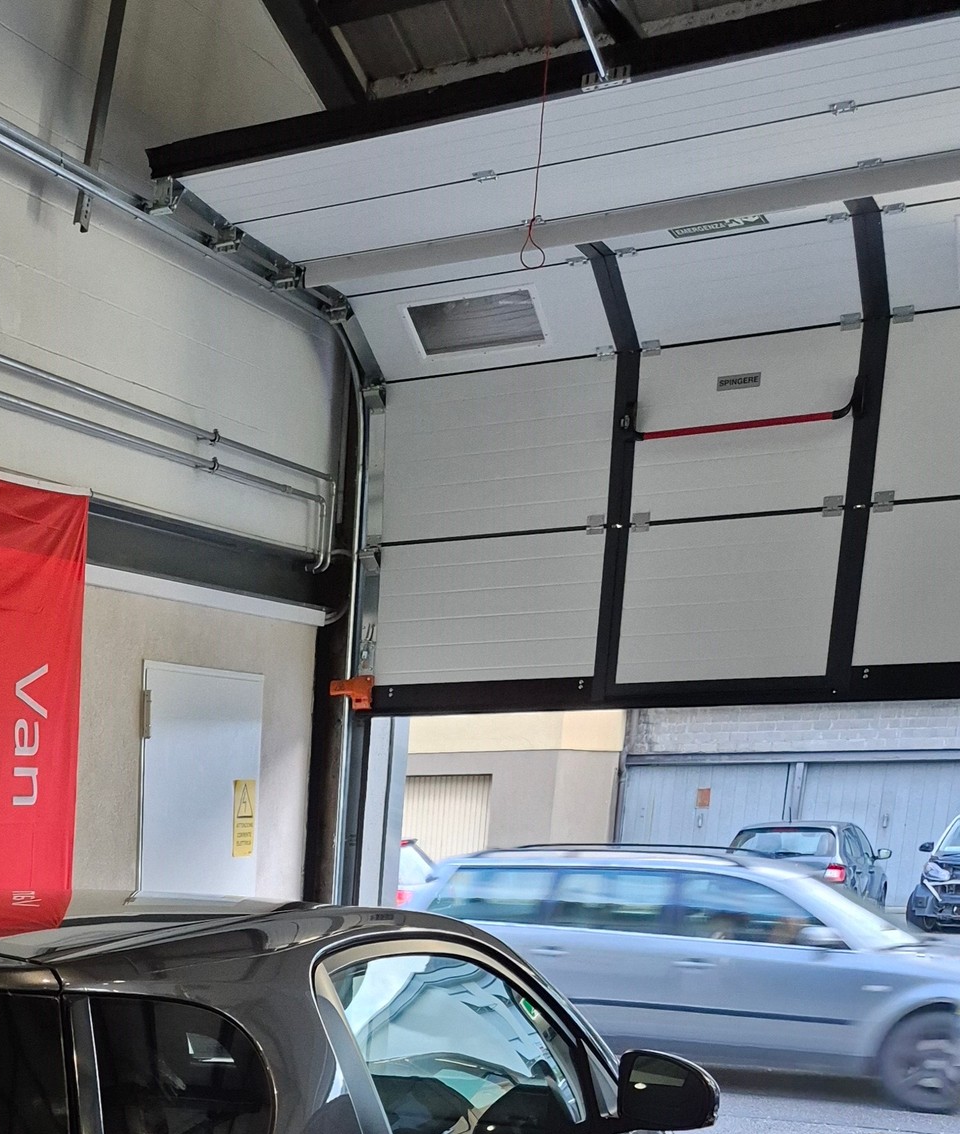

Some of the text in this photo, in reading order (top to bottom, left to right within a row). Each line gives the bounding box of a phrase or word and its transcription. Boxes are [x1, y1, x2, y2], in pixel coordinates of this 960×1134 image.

[675, 222, 726, 236] EMERGENZA
[719, 375, 759, 387] SPINGERE
[12, 664, 49, 807] Van
